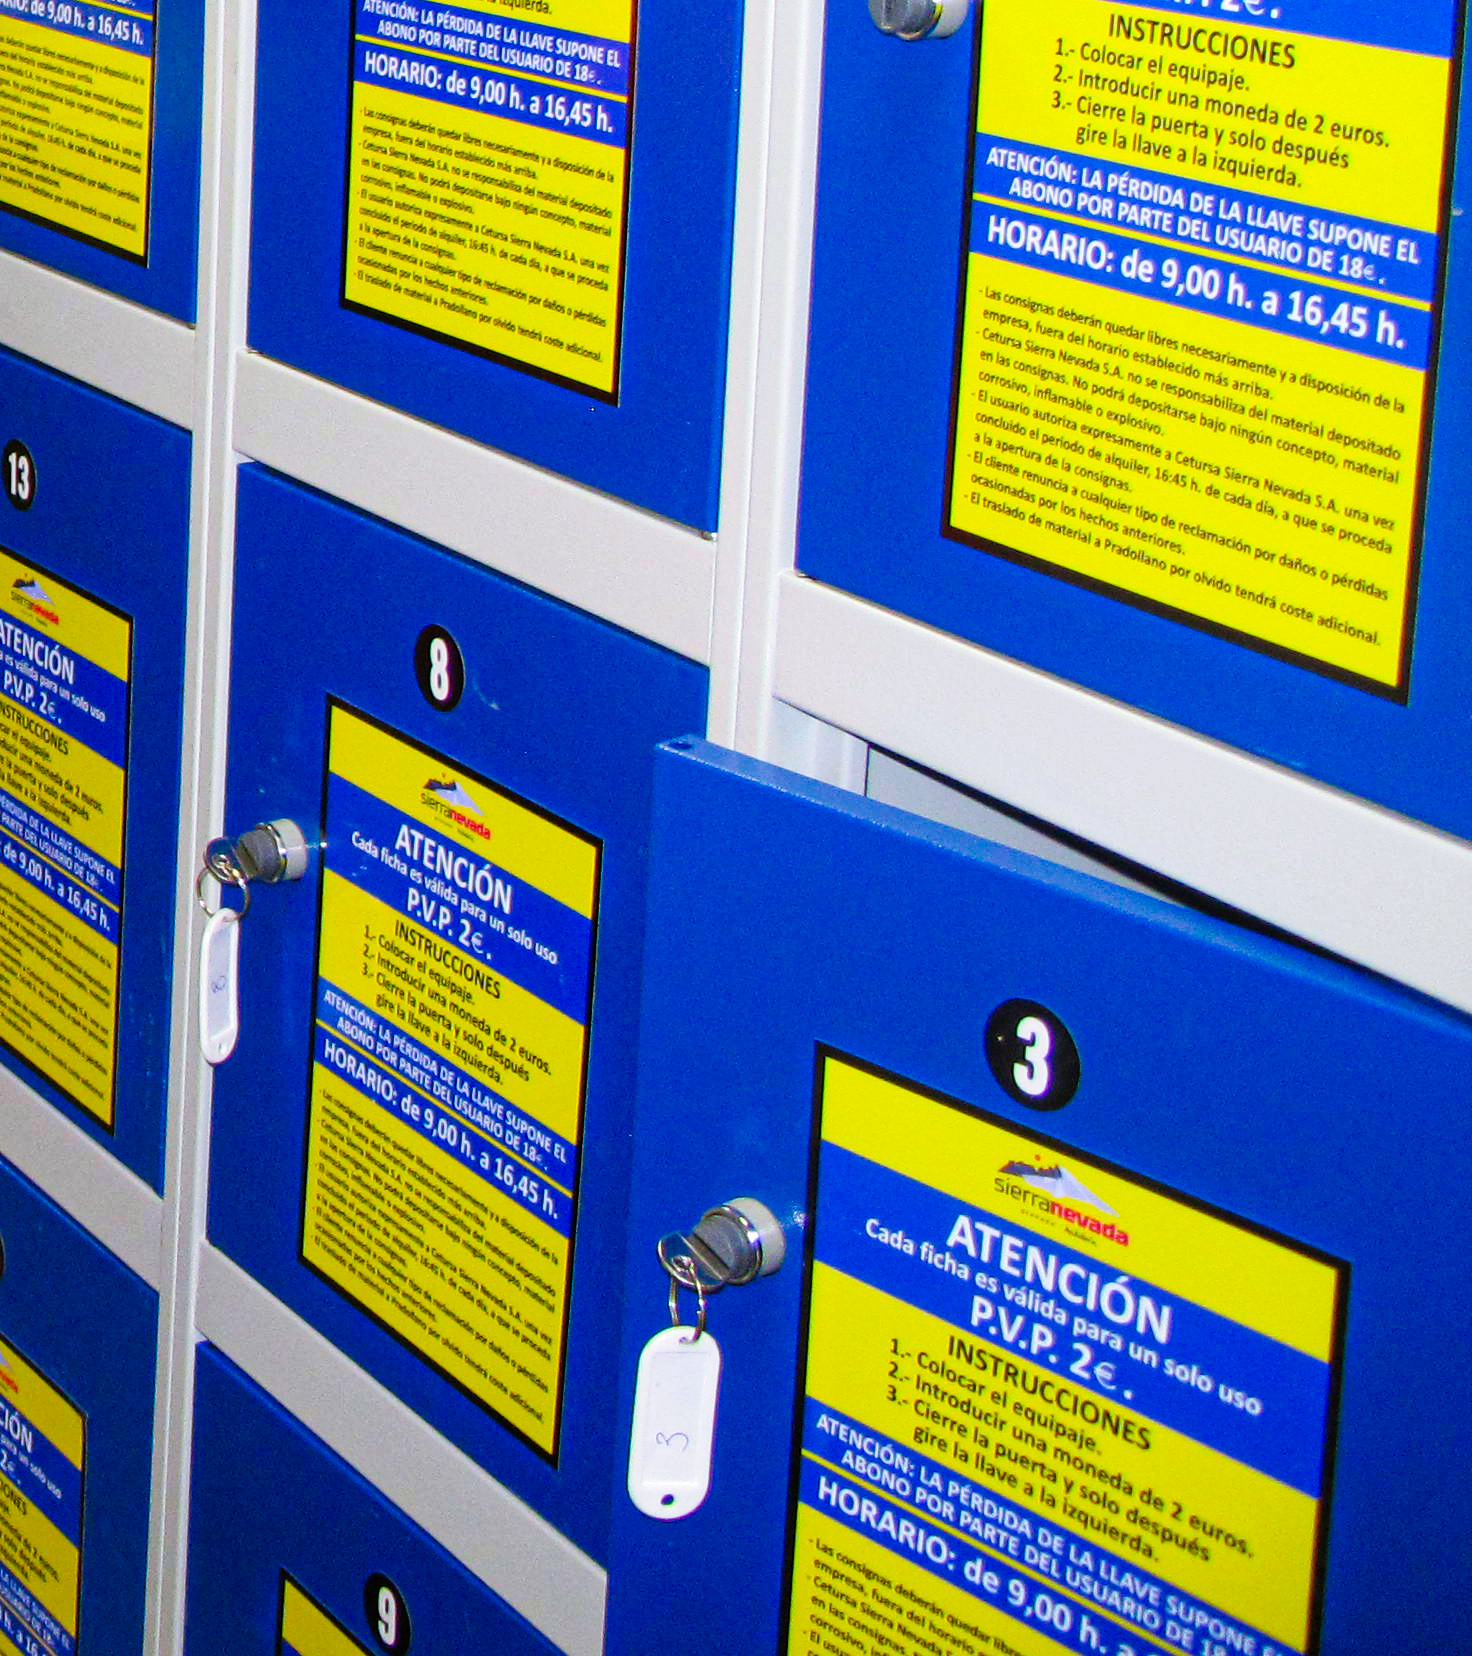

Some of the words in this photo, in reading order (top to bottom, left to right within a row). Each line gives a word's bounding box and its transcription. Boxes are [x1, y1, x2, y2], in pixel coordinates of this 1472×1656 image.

[365, 50, 443, 90] HORARIO:
[1055, 37, 1075, 57] 1.-
[1079, 42, 1144, 70] Colocar
[1147, 55, 1163, 75] el
[1167, 62, 1249, 92] equipaje.
[1109, 13, 1295, 69] INSTRUCCIONES
[1051, 90, 1072, 110] 3.-
[1076, 95, 1126, 123] Cierre
[1131, 105, 1146, 127] la
[1150, 115, 1209, 140] puerta
[1214, 127, 1224, 147] y
[1229, 128, 1266, 151] solo
[1271, 135, 1349, 169] después
[1053, 63, 1073, 83] 2.-
[1078, 69, 1163, 101] Introducir
[1167, 90, 1199, 110] una
[1205, 98, 1279, 126] moneda
[1284, 108, 1308, 132] de
[1313, 114, 1325, 135] 2
[1330, 122, 1389, 148] euros.
[1075, 123, 1108, 146] gire
[1112, 128, 1127, 150] la
[1132, 133, 1172, 160] llave
[1177, 148, 1187, 163] a
[1192, 145, 1207, 167] la
[1213, 150, 1302, 188] izquierda.
[986, 147, 1077, 184] ATENCIÓN:
[1081, 167, 1103, 191] LA
[1107, 171, 1185, 209] PÉRDIDA
[1189, 192, 1215, 216] DE
[1218, 198, 1242, 223] LA
[1247, 205, 1304, 237] LLAVE
[1307, 219, 1392, 258] SUPONE
[1396, 239, 1419, 265] EL
[1008, 177, 1074, 208] ABONO
[1077, 192, 1114, 219] POR
[1118, 202, 1173, 233] PARTE
[1178, 216, 1212, 243] DEL
[1215, 225, 1303, 265] USUARIO
[1307, 246, 1334, 272] DE
[988, 215, 1114, 273] HORARIO:
[1121, 248, 1155, 283] de
[1161, 258, 1221, 300] 9,00
[1227, 272, 1252, 309] h.
[1261, 291, 1280, 316] a
[1287, 290, 1368, 338] 16,45
[1377, 310, 1404, 349] h.
[983, 309, 1032, 333] empresa,
[1035, 320, 1064, 340] fuera
[1066, 331, 1085, 346] del
[1087, 335, 1130, 359] horario
[1132, 351, 1200, 379] establecido
[1203, 371, 1229, 387] más
[1232, 380, 1273, 400] arriba.
[9, 453, 29, 499] 13
[970, 473, 1036, 504] ocasionadas
[1038, 496, 1058, 510] por
[1060, 500, 1076, 518] los
[1078, 507, 1119, 532] hechos
[1122, 525, 1185, 555] anteriores.
[430, 638, 449, 702] 8
[395, 823, 512, 915] ATENCIÓN
[395, 919, 501, 1000] INSTRUCCIONES
[325, 1038, 398, 1106] HORARIO:
[1014, 1017, 1050, 1095] 3
[994, 1178, 1128, 1247] sierranevada
[946, 1214, 1171, 1344] ATENCIÓN
[949, 1335, 1151, 1451] INSTRUCCIONES
[656, 1432, 690, 1452] 3
[378, 1589, 396, 1645] 9
